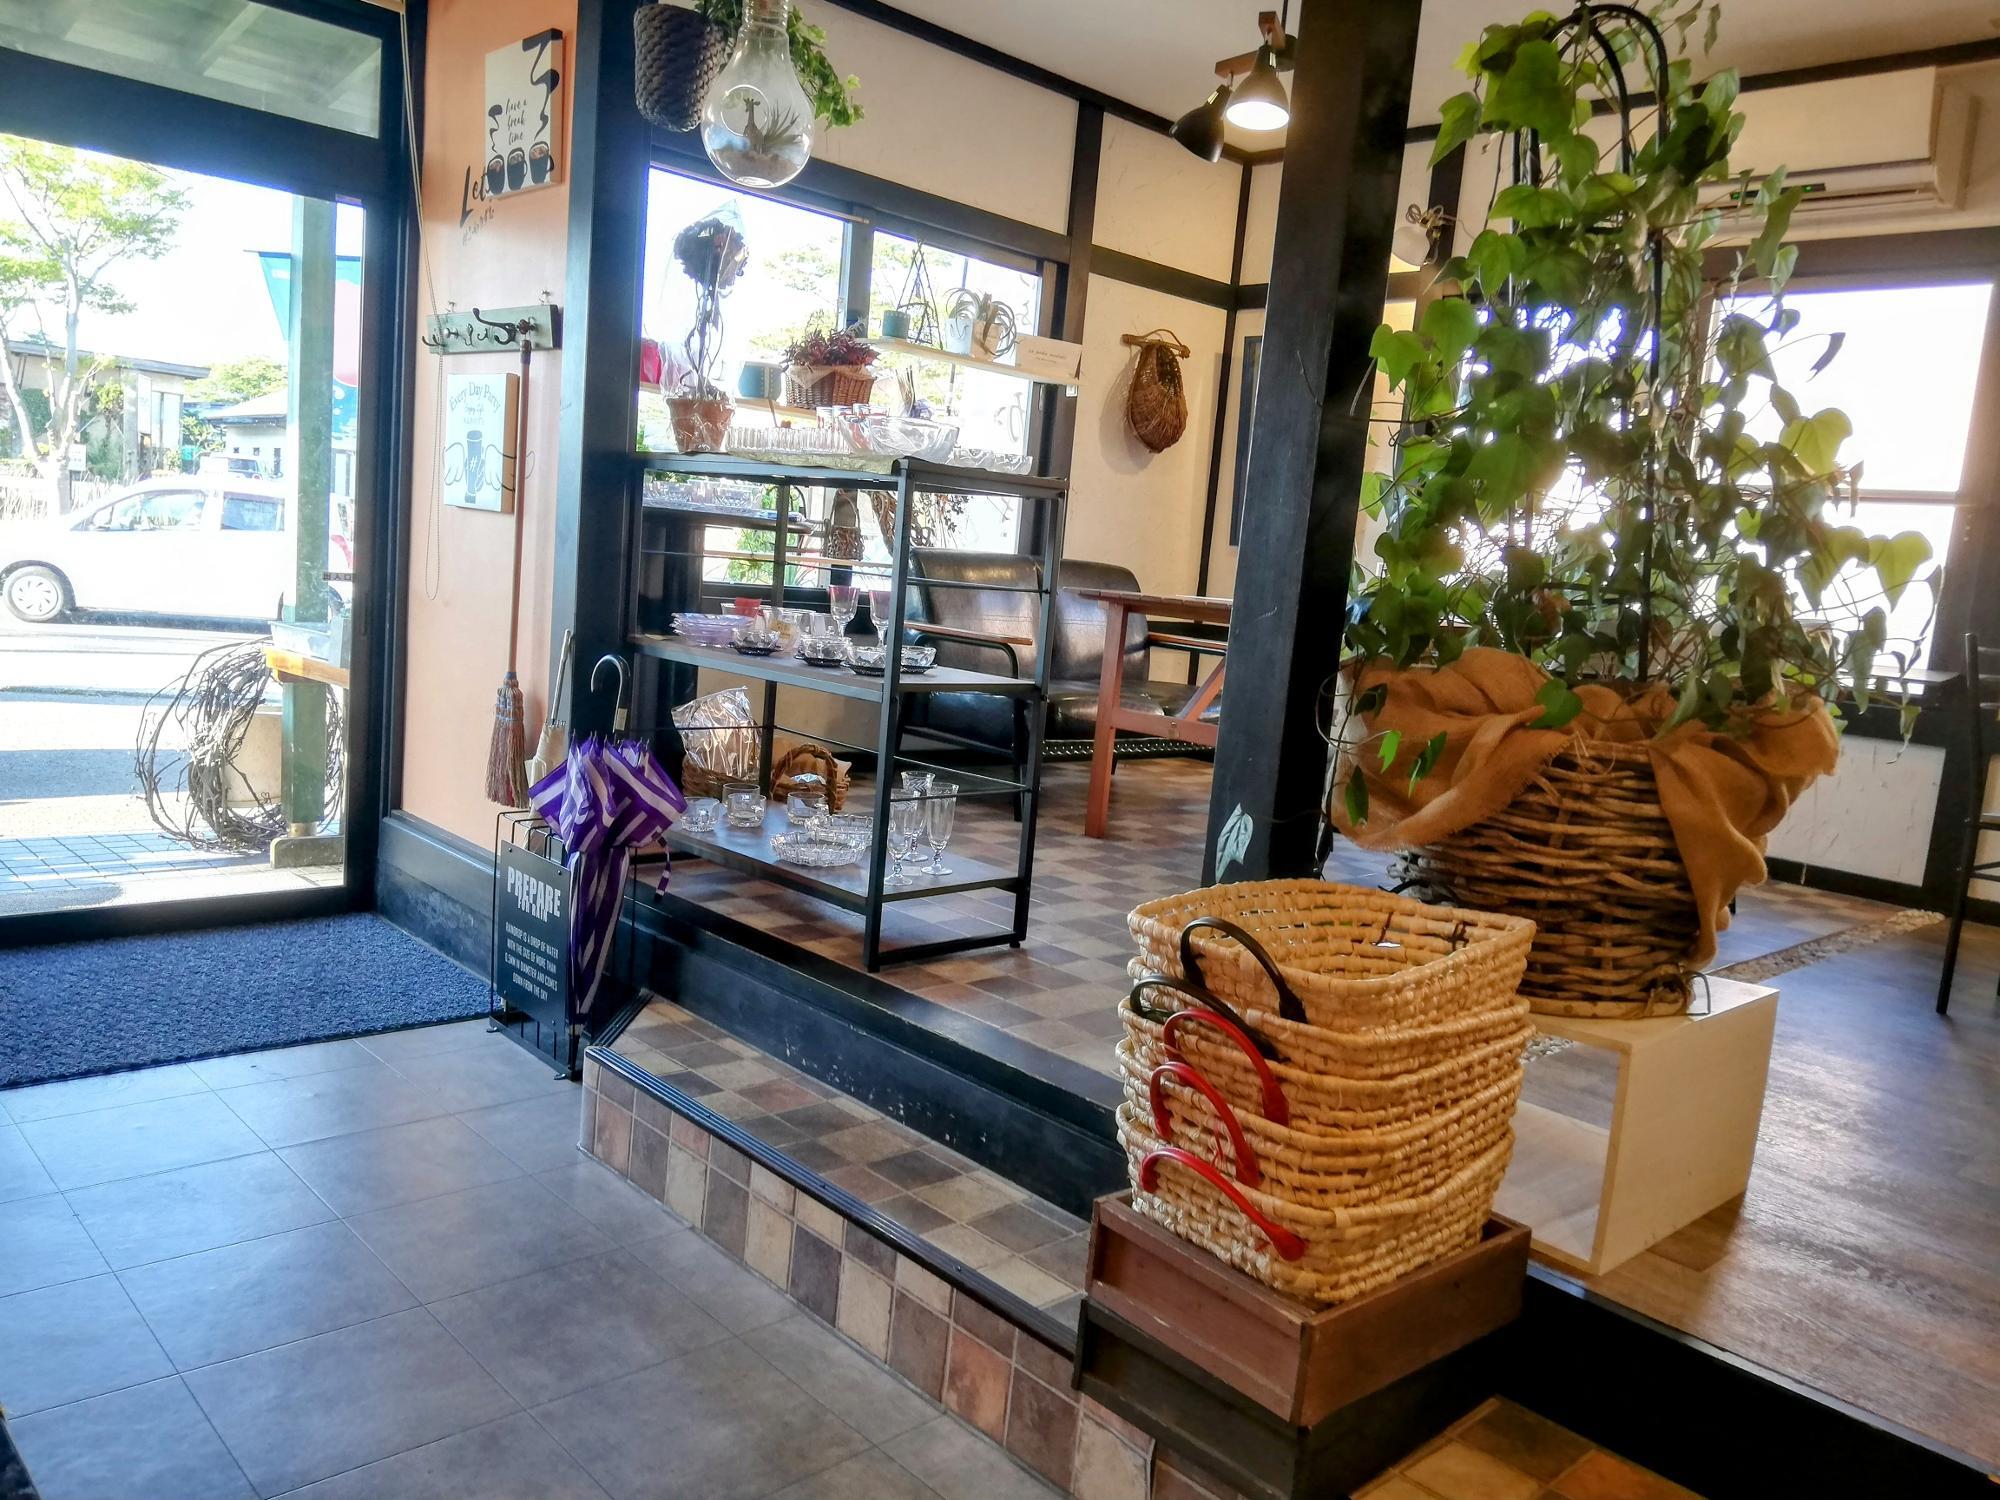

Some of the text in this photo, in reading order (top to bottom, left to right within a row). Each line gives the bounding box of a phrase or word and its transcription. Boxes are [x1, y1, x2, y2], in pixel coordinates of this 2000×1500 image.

[449, 381, 501, 413] Every Day Party
[507, 865, 561, 918] PREPARE
[517, 892, 548, 923] FOR RAIN
[505, 921, 522, 939] RAINDROP
[523, 931, 527, 943] IS
[531, 935, 540, 948] DROP
[540, 941, 546, 952] OF
[546, 943, 558, 960] WATER
[507, 938, 515, 951] WITH
[515, 942, 523, 956] THE
[531, 951, 536, 963] OF
[536, 954, 546, 969] MORE
[546, 959, 556, 974] THAN
[512, 971, 523, 987] DOWN
[523, 978, 533, 993] FROM
[540, 988, 548, 1002] SKY
[516, 958, 520, 969] IN
[520, 960, 537, 979] DIAMETER
[544, 975, 558, 992] COMES
